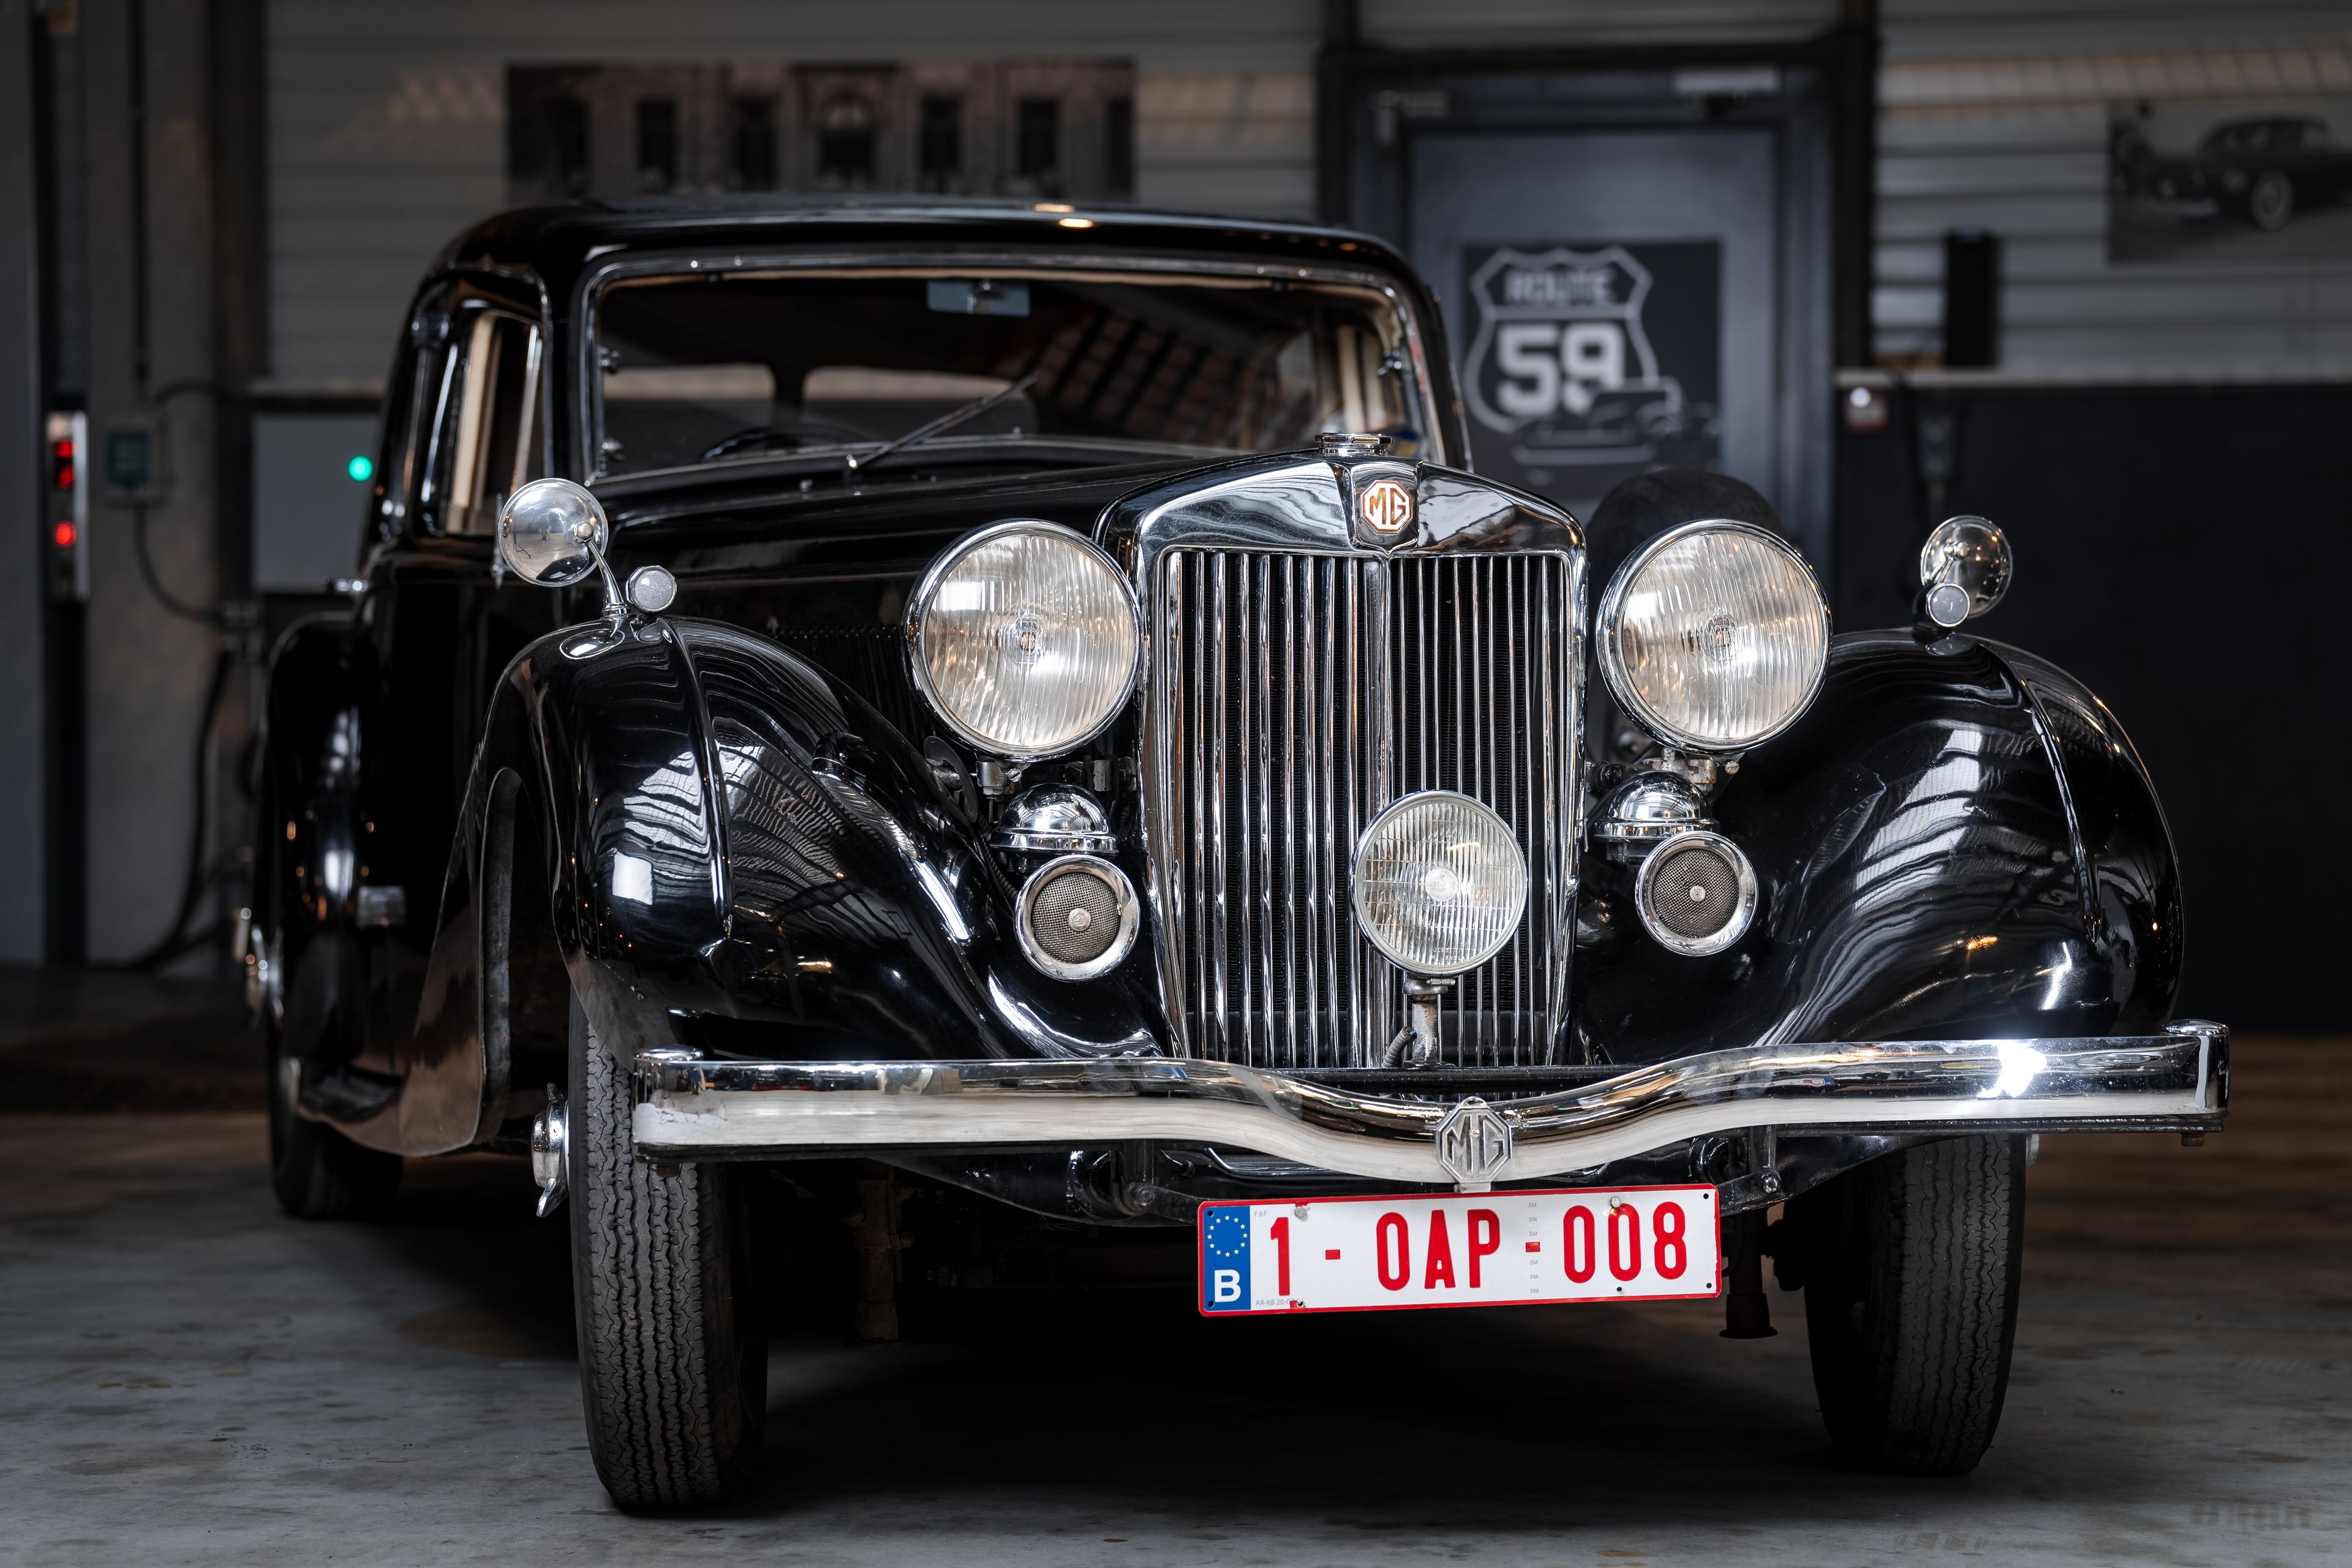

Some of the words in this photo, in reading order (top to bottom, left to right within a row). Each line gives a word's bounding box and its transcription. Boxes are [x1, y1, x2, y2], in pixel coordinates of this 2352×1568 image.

[1496, 322, 1626, 416] 59
[1370, 488, 1406, 525] MG
[1446, 1114, 1505, 1175] MG
[1214, 1269, 1242, 1303] B
